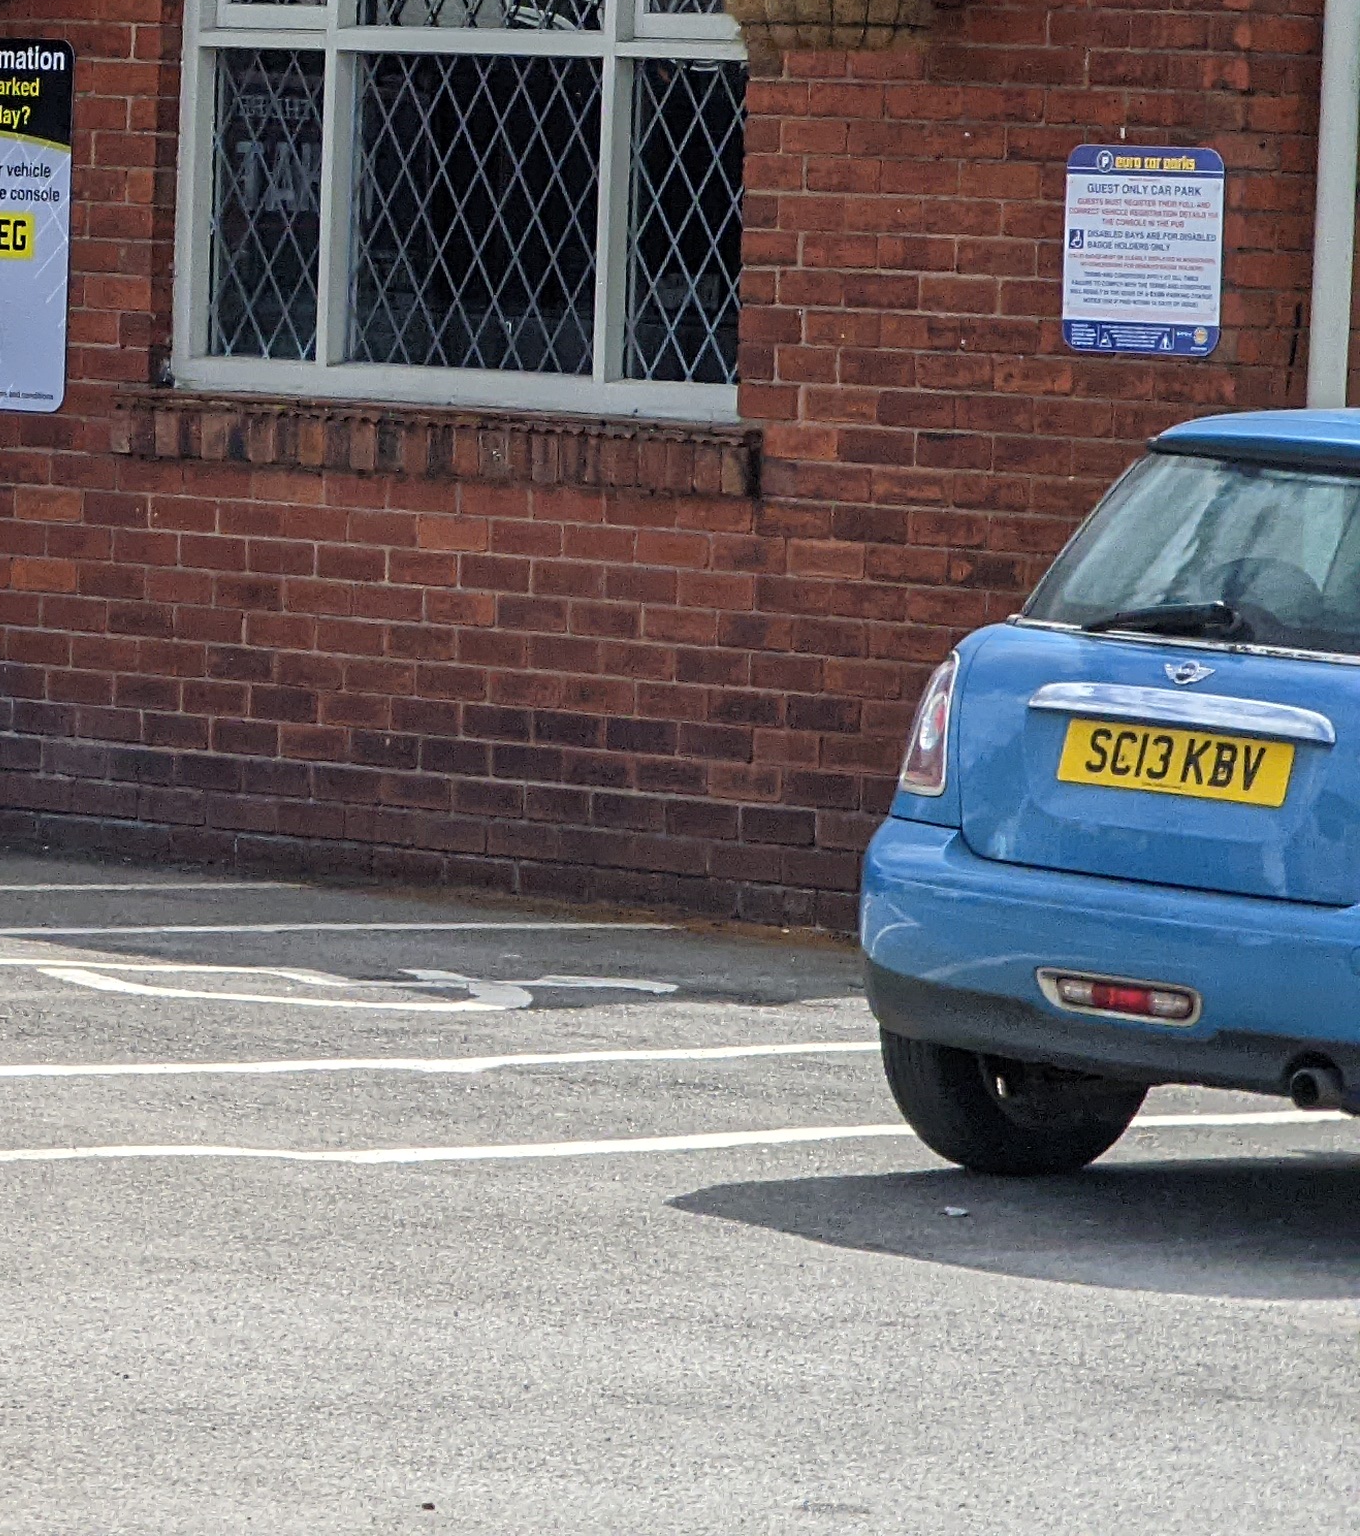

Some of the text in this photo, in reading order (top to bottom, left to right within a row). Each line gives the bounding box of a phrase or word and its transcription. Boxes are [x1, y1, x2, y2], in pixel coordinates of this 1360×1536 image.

[6, 162, 51, 179] vehicle
[9, 186, 60, 203] console
[1087, 183, 1202, 196] GUEST ONLY CAR PARK
[1085, 728, 1266, 791] SC13 KBV
